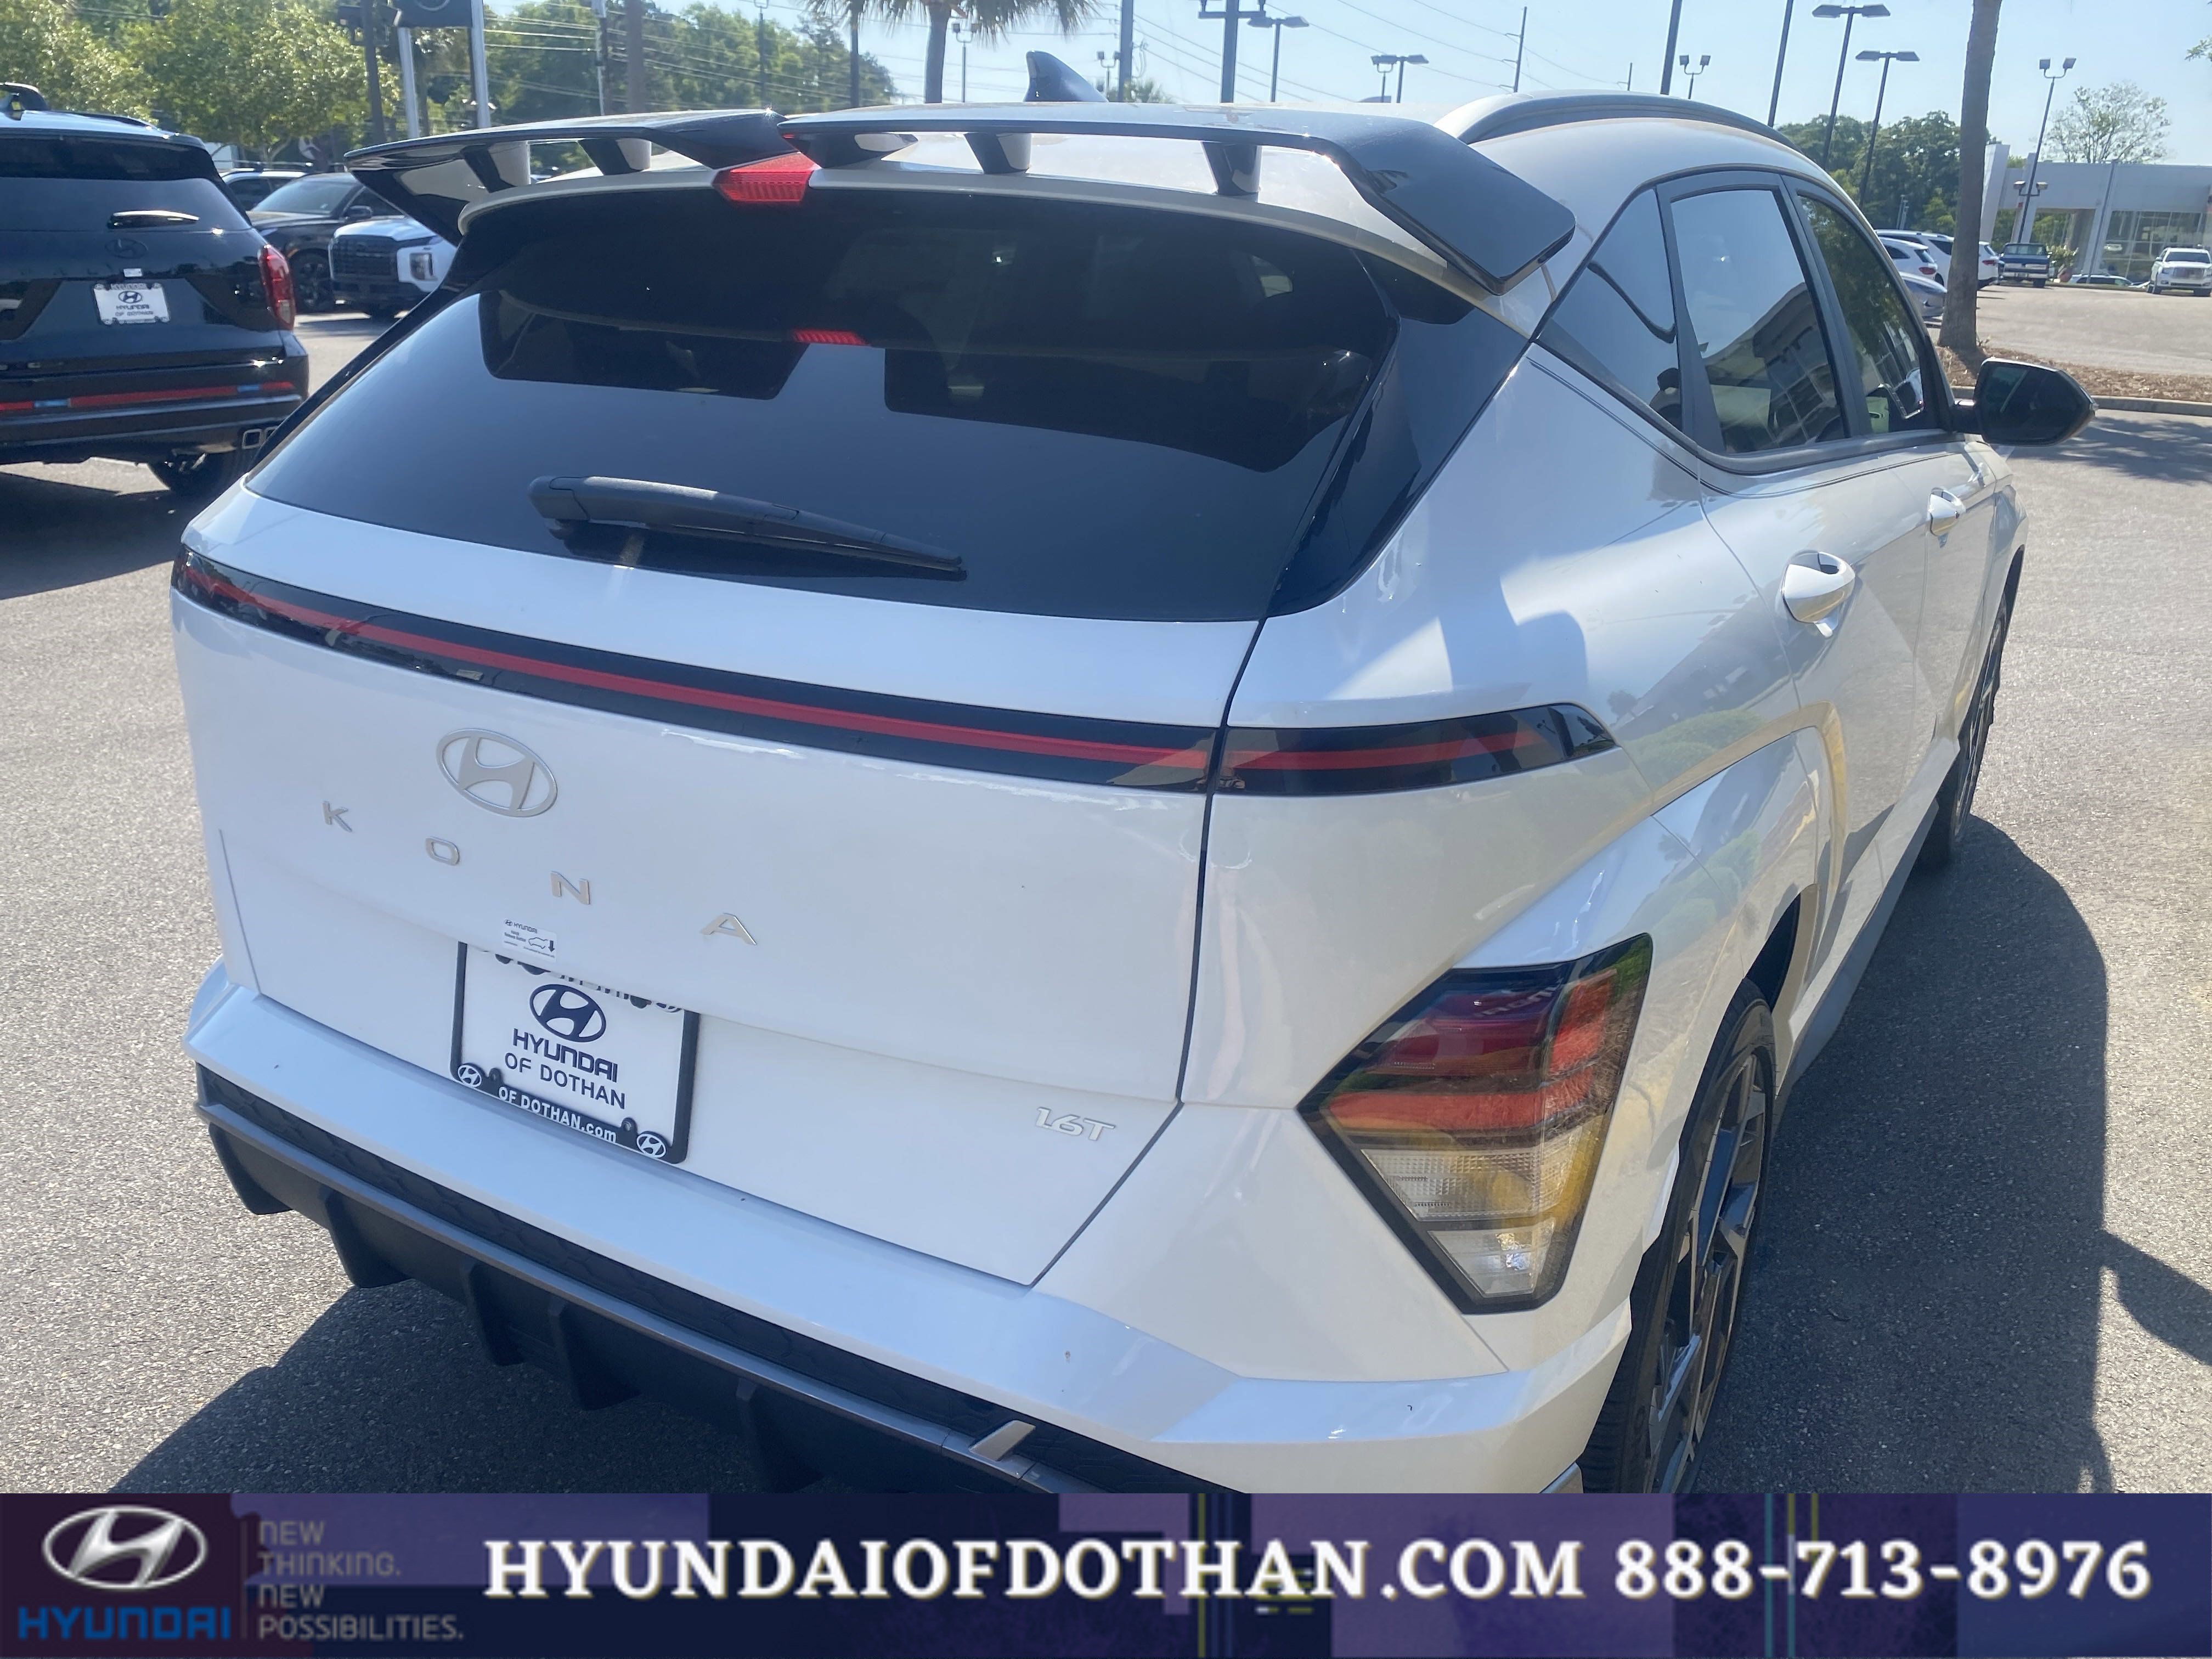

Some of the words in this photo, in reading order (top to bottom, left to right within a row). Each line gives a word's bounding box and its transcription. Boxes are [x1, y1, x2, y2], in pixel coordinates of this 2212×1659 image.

[322, 801, 757, 945] KONA
[514, 922, 538, 934] HYUNDAI
[504, 1052, 532, 1073] OF
[540, 1064, 626, 1110] DOTHAN
[512, 1028, 618, 1083] HYUNDAI
[498, 1086, 517, 1104] OF
[521, 1094, 617, 1144] DOTHAN.com
